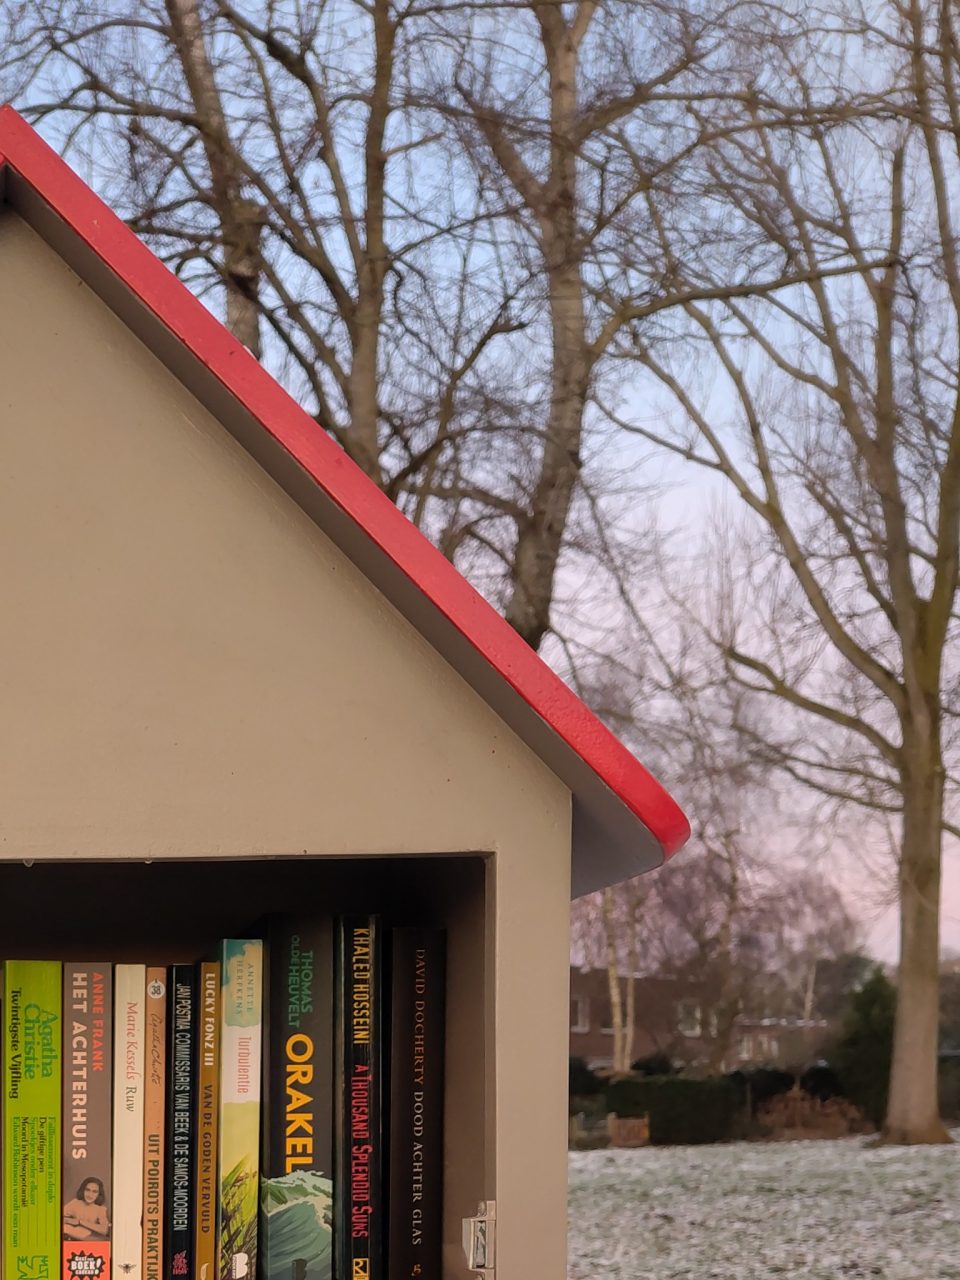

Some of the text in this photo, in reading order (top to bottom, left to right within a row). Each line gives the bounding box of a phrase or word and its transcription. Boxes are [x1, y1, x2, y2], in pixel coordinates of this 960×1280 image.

[176, 984, 191, 999] JAN
[176, 1000, 191, 1030] POSTMA
[204, 973, 216, 1066] LUCKY FONZ III
[246, 963, 254, 1013] ANNETTE
[288, 935, 301, 1028] OLDE HEUVELT
[300, 950, 314, 1013] THOMAS
[352, 928, 371, 1045] KHALED HOSSEINI
[414, 948, 426, 1086] DAVID DOCHERTY
[8, 987, 22, 1099] Twintigste Vijfling
[24, 1003, 42, 1080] Christie
[38, 1009, 58, 1078] Agatha
[91, 971, 104, 1072] ANNE FRANK
[126, 1002, 141, 1081] Marie Kessels
[72, 972, 88, 1161] HET ACHTERHUIS
[126, 1086, 137, 1112] Ruw
[175, 1032, 191, 1091] COMMISSARIS
[237, 1036, 252, 1094] Turbulentie
[21, 1116, 29, 1143] Moord
[174, 1111, 189, 1135] BEEK
[175, 1093, 189, 1110] VAN
[285, 1033, 315, 1176] ORAKEL
[37, 1116, 46, 1173] De giftige pen
[174, 1143, 188, 1156] DE
[200, 1084, 212, 1234] VAN DE GODEN VERVULD
[351, 1064, 373, 1238] A THOUSAND SPLENDID SUNS
[411, 1091, 425, 1246] DOOD ACHTER GLAS
[146, 1134, 160, 1280] UIT POIROTS PRAKTIJK
[173, 1157, 188, 1232] SAMOS-MOORDEN
